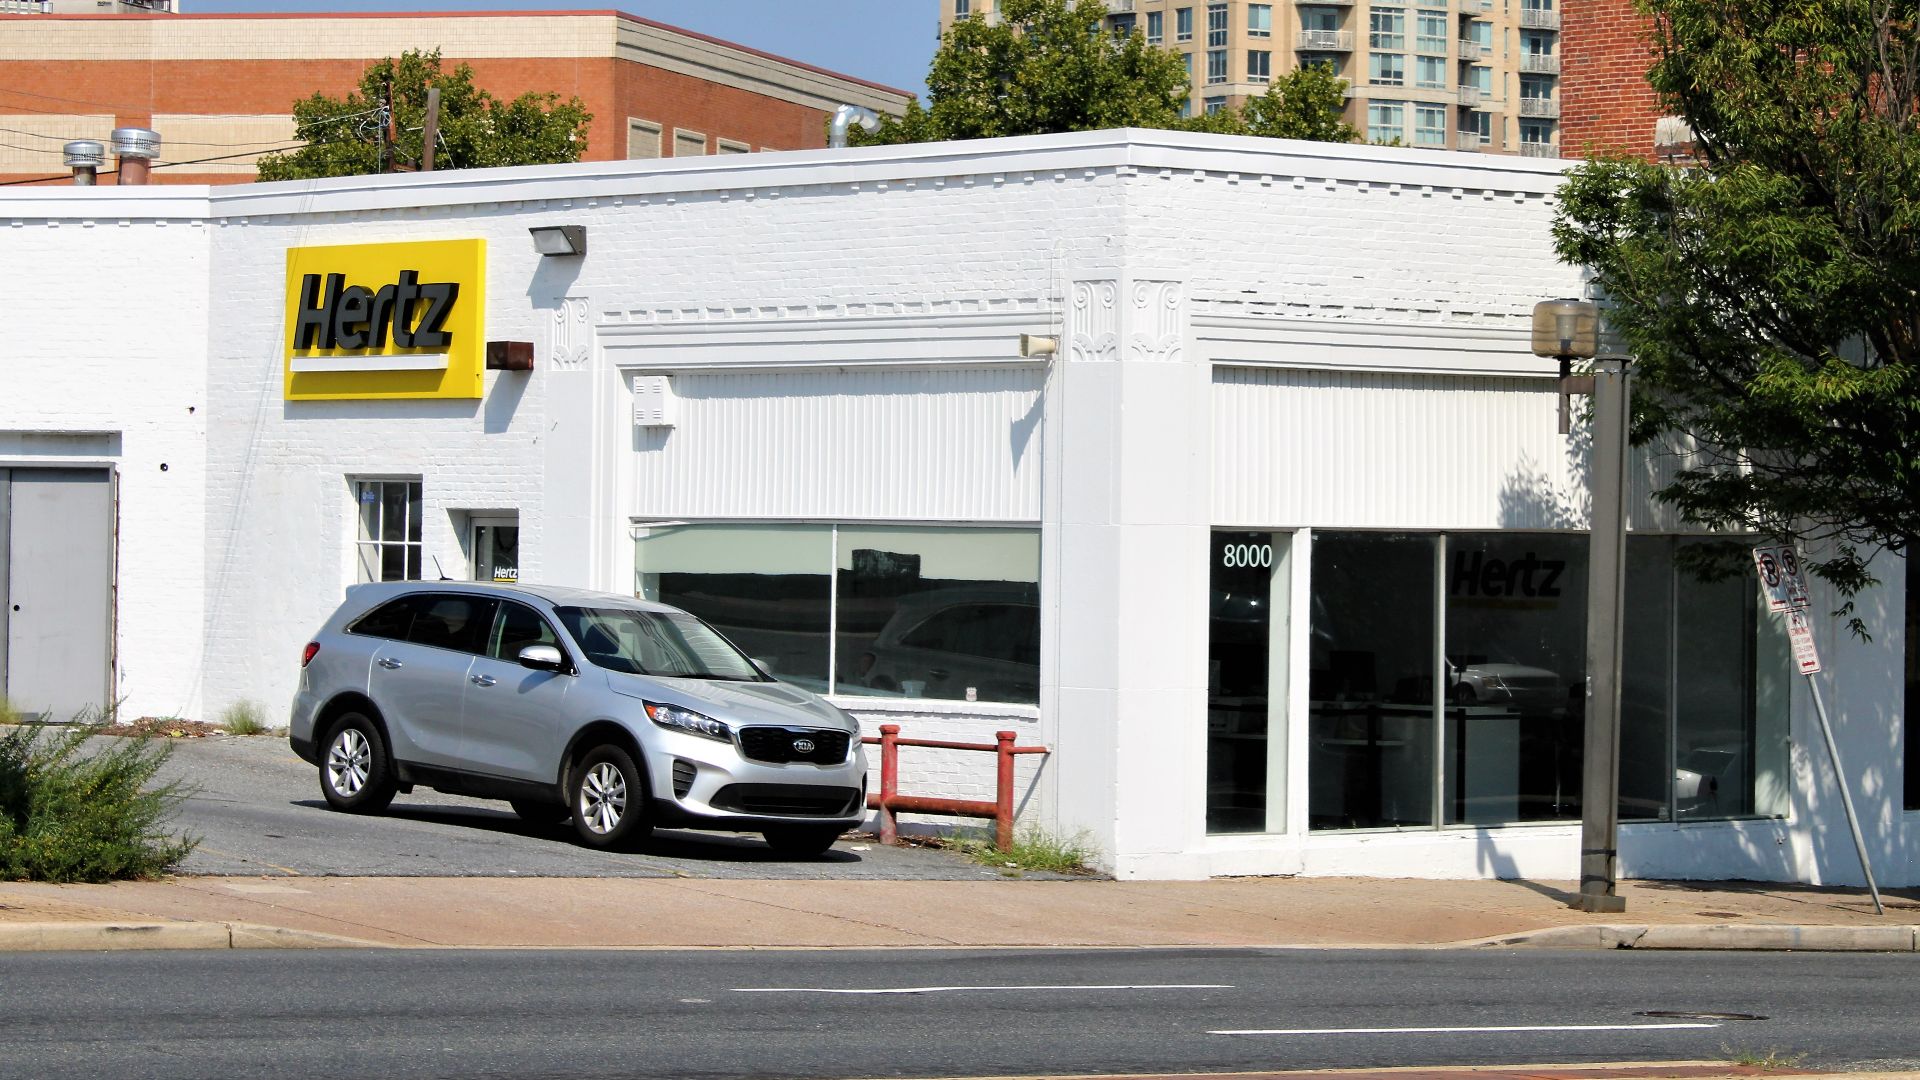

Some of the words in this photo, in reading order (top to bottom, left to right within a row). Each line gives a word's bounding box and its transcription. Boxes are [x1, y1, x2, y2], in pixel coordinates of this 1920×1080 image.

[293, 270, 459, 349] Hertz
[494, 566, 518, 579] Hertz
[1223, 544, 1272, 568] 8000
[1451, 551, 1566, 597] Hertz
